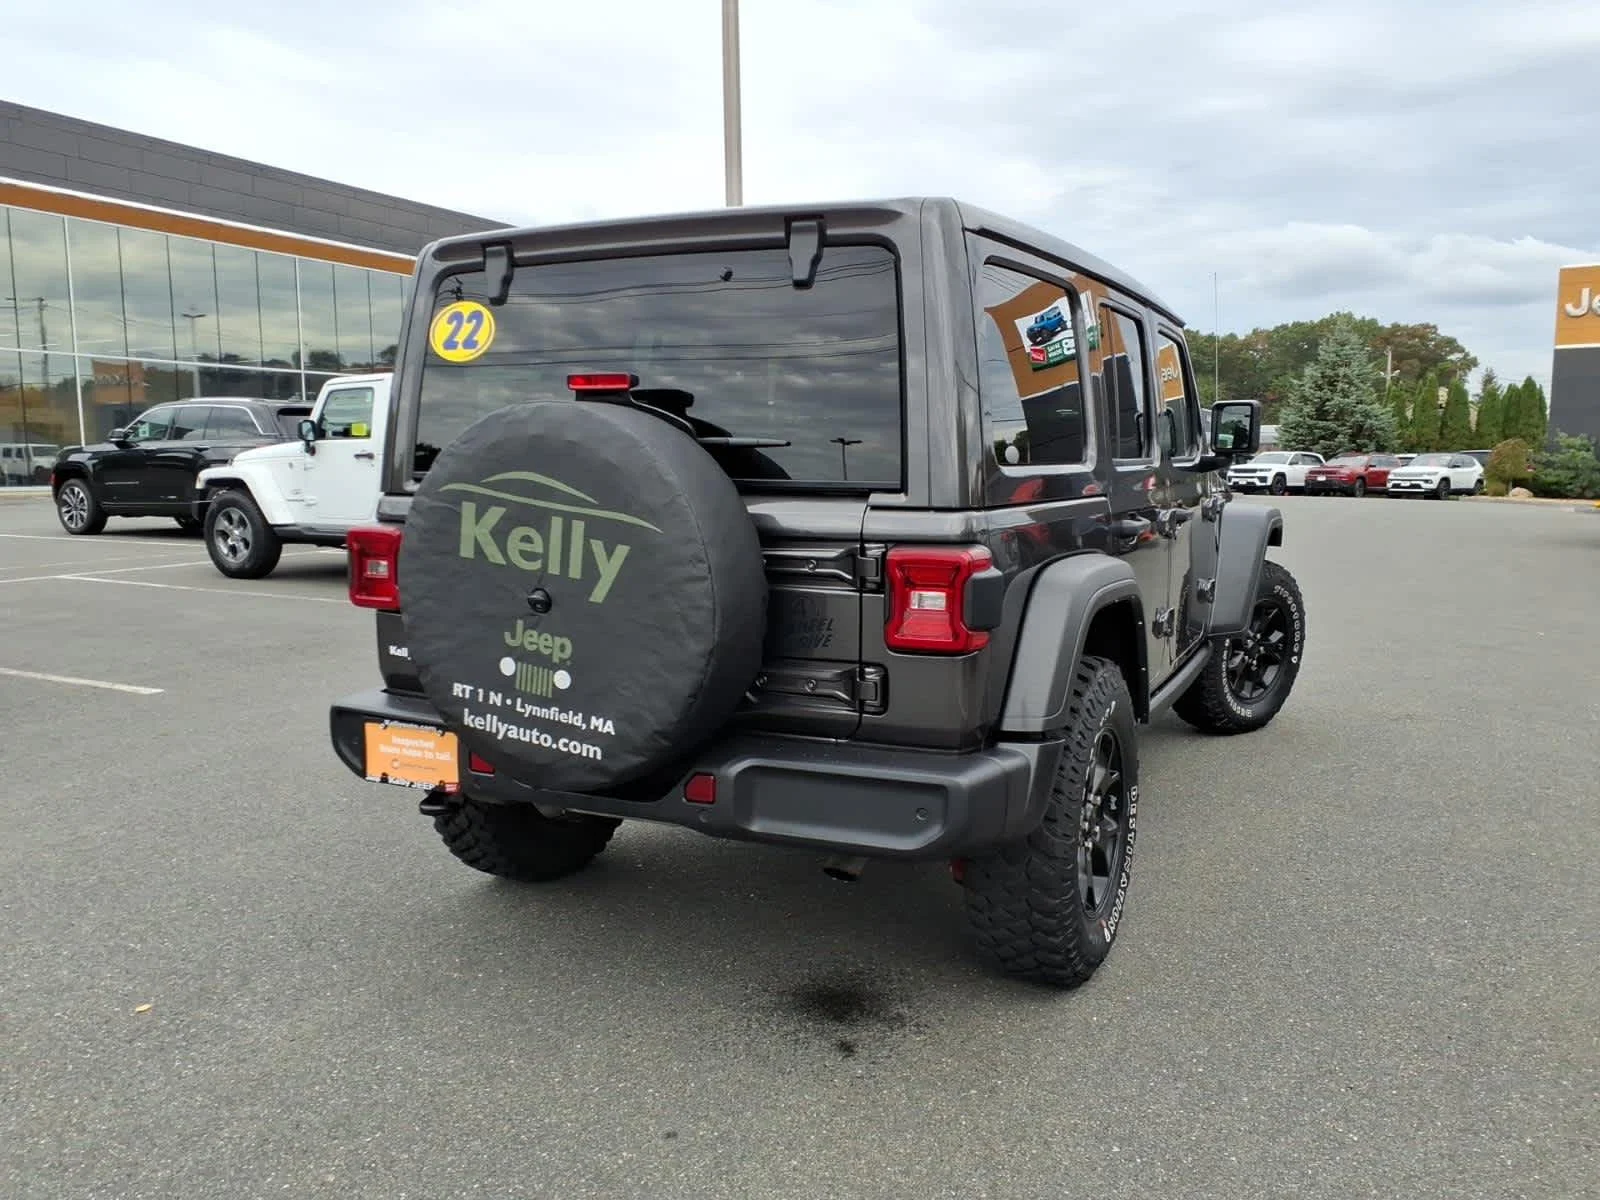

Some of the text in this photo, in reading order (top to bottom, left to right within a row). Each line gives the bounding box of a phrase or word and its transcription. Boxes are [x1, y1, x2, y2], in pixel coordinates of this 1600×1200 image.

[443, 310, 484, 350] 22
[459, 500, 631, 604] Kelly
[389, 645, 411, 660] Kell
[504, 619, 573, 664] Jeep
[452, 682, 616, 736] RT 1 N Lynnfield, MA
[463, 708, 602, 760] kellyauto.com
